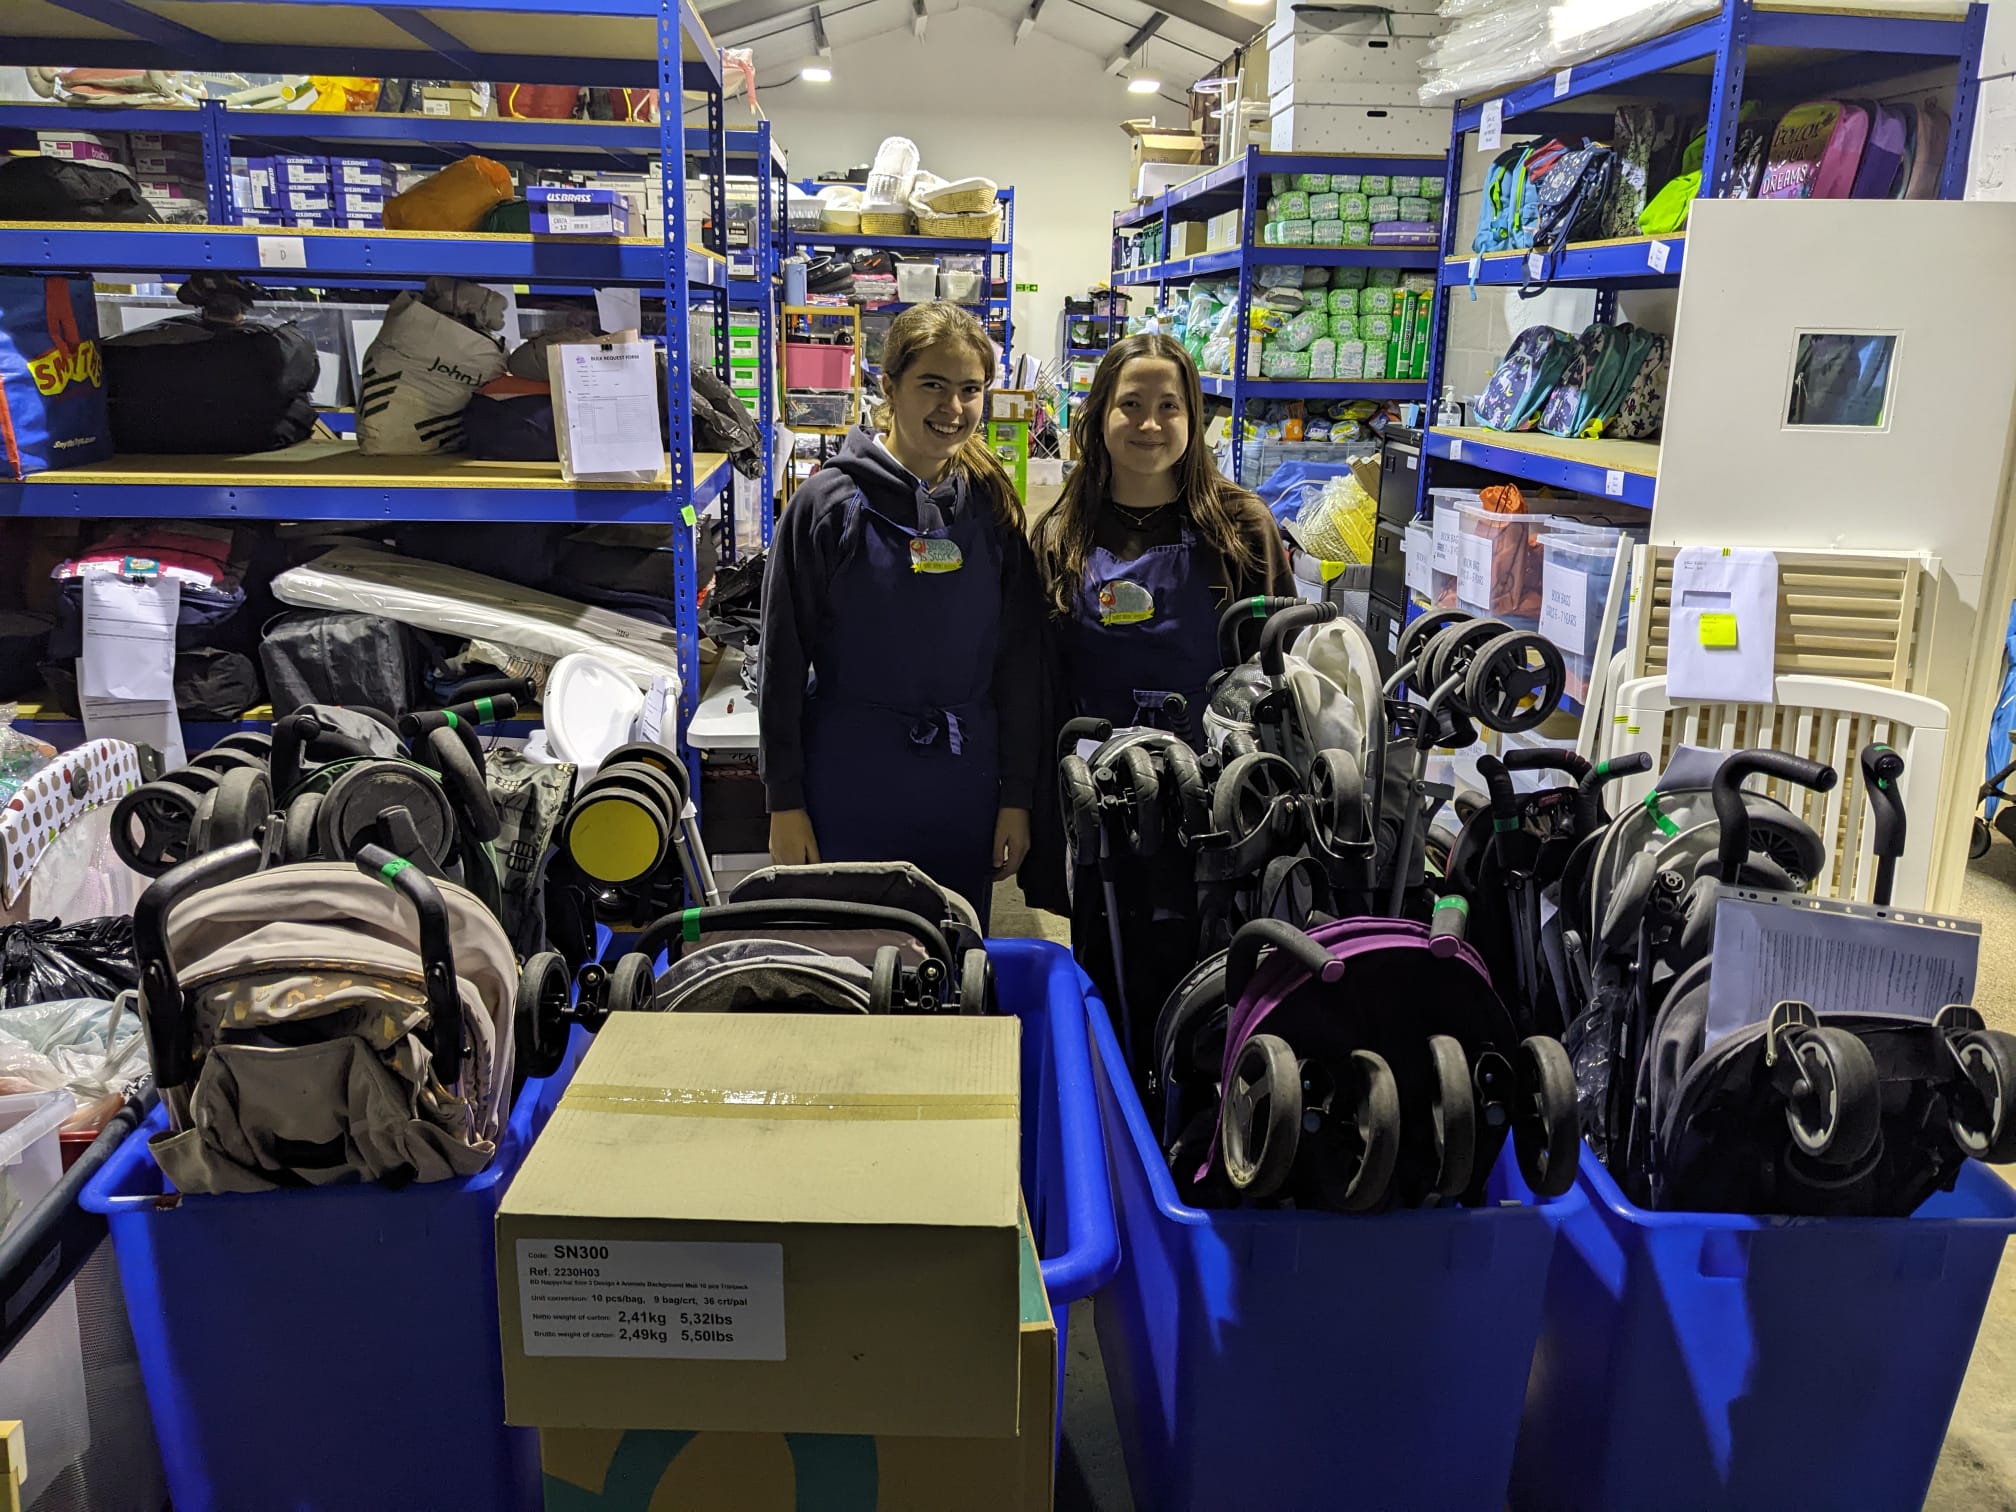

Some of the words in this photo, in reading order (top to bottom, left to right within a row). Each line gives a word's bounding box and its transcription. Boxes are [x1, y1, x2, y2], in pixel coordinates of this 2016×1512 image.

[1762, 163, 1808, 195] DREAMS
[427, 356, 473, 385] John
[1551, 589, 1561, 603] BOOK
[1560, 591, 1571, 608] BAGS
[1564, 611, 1577, 628] YEARS
[553, 1245, 609, 1260] SN300
[529, 1267, 550, 1277] Ref.
[554, 1267, 600, 1277] 2230H03
[647, 1281, 684, 1289] Background
[591, 1294, 603, 1302] 10
[605, 1294, 646, 1304] pcs/bag,
[662, 1296, 699, 1306] bag/crt,
[703, 1297, 715, 1305] 36
[717, 1298, 748, 1307] crt/pal
[552, 1313, 577, 1322] weight
[618, 1311, 666, 1326] 2,41kg
[680, 1312, 733, 1326] 5,32lbs
[557, 1331, 582, 1339] weight
[619, 1328, 668, 1343] 2,49kg
[681, 1329, 734, 1342] 5,50lbs
